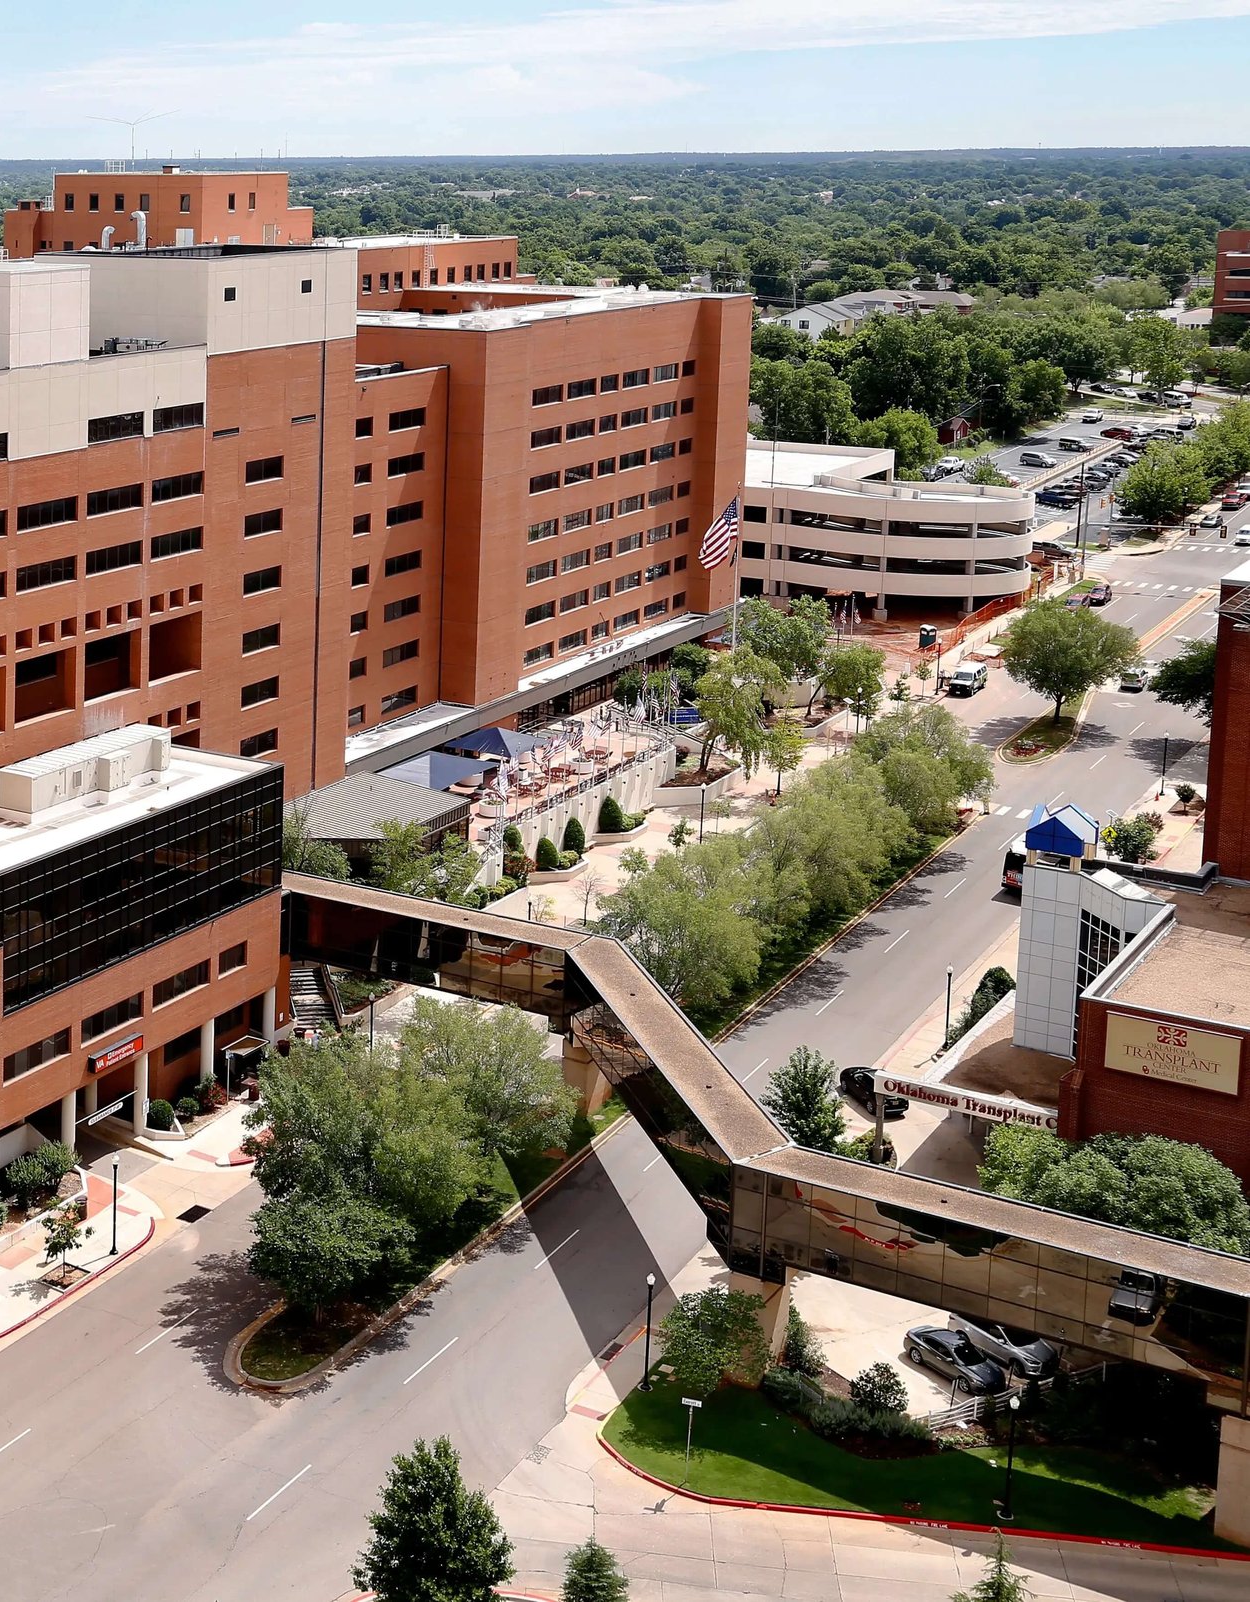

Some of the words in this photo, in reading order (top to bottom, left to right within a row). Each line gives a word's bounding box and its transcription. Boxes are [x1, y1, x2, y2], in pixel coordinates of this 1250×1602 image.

[1146, 1042, 1196, 1058] OKLAHOMA
[1123, 1045, 1222, 1074] TRANSPLANT
[1151, 1069, 1175, 1079] Medical
[1152, 1062, 1187, 1074] CENTER
[883, 1079, 958, 1107] Oklahoma
[962, 1096, 1042, 1126] Transplant
